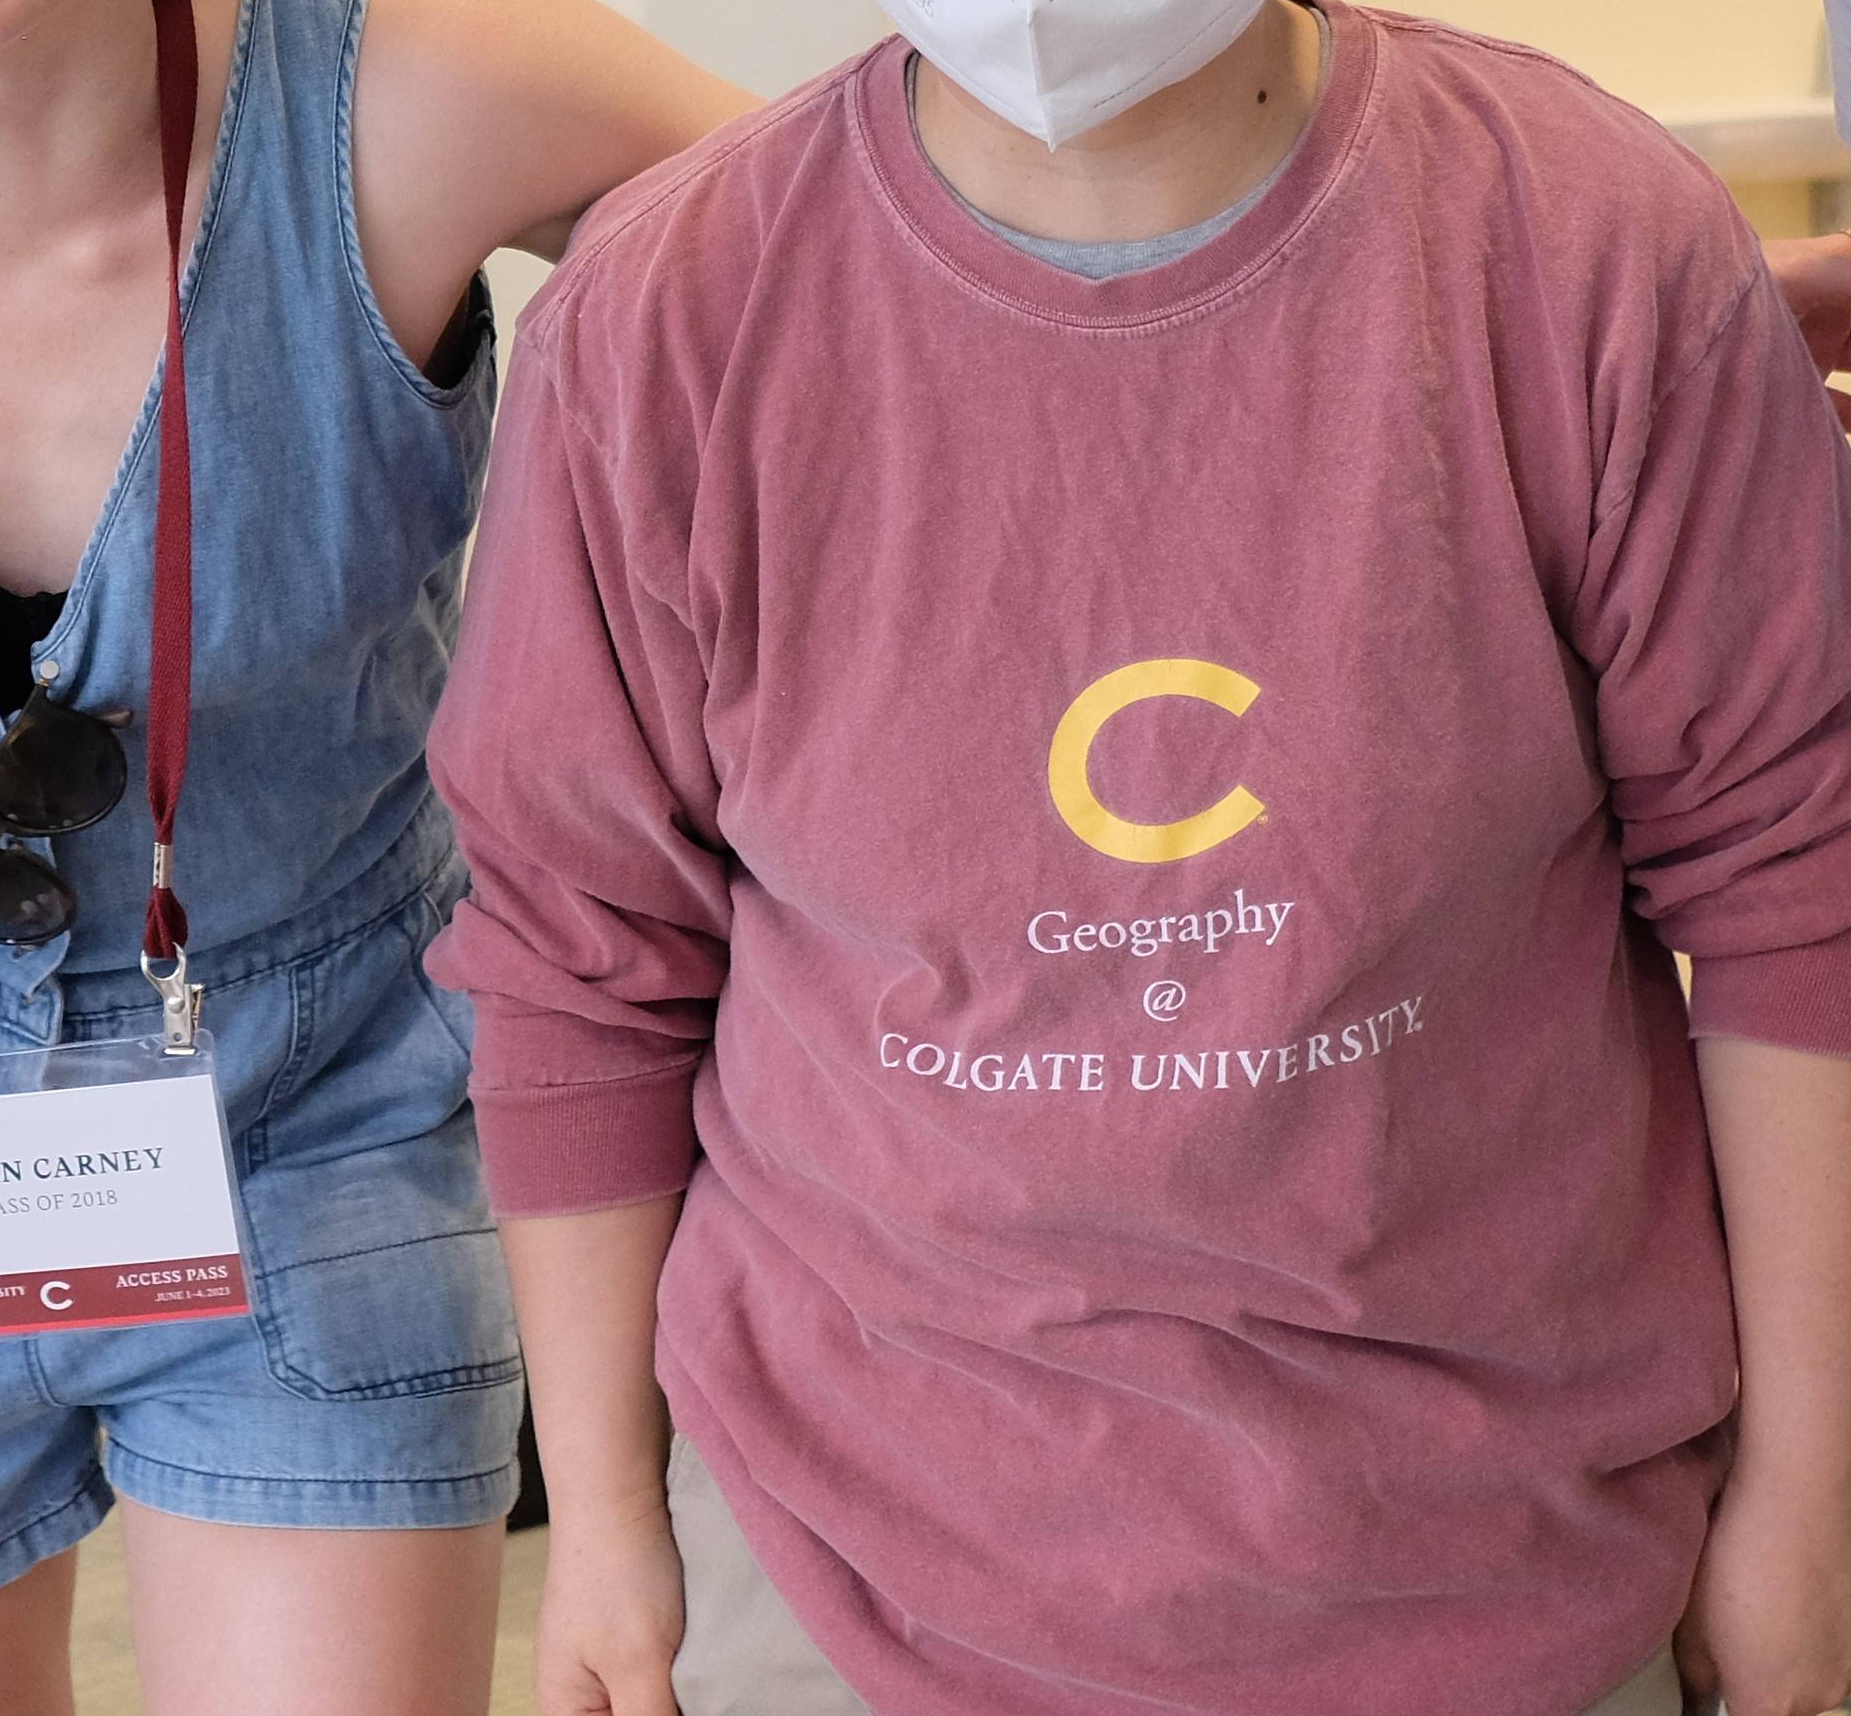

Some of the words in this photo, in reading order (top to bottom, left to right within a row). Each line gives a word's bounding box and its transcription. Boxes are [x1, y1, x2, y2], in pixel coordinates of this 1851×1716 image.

[1048, 658, 1266, 863] C
[1027, 888, 1295, 957] Geography
[1142, 980, 1187, 1022] @
[879, 1032, 1104, 1093] COLGATE
[1130, 994, 1423, 1091] UNIVERSITY
[32, 1146, 165, 1180] CARNEY
[36, 1192, 65, 1211] OF
[71, 1189, 119, 1209] 2018
[115, 1270, 182, 1288] ACCESS
[186, 1265, 229, 1282] PASS
[39, 1280, 74, 1311] C
[154, 1290, 184, 1302] JUNE
